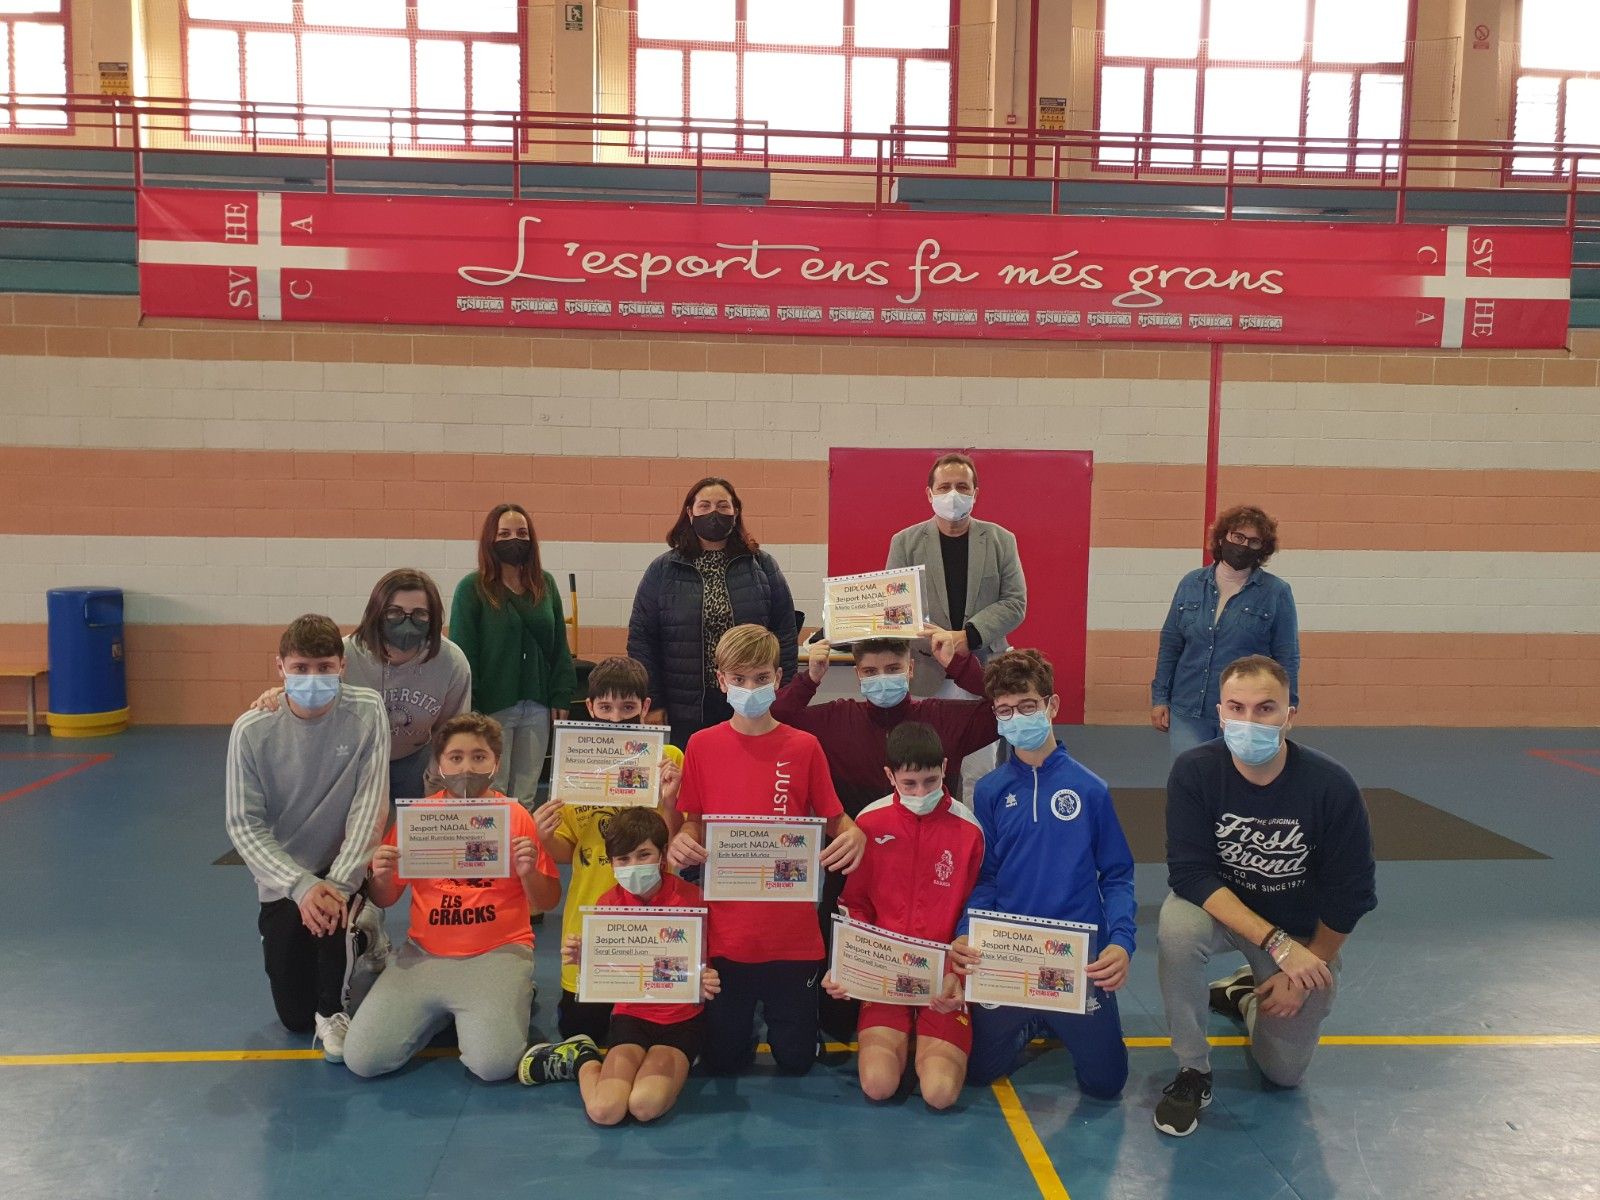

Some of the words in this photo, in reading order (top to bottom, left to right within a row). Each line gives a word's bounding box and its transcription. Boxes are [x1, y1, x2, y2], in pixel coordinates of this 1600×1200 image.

[289, 214, 313, 234] A
[457, 215, 819, 294] L'esport
[800, 257, 890, 286] ens
[896, 238, 979, 304] fa
[999, 250, 1104, 290] més
[1111, 264, 1285, 308] grans
[290, 279, 313, 300] C
[575, 302, 611, 312] SUECA
[736, 307, 770, 318] SUECA
[943, 312, 977, 322] SUECA
[995, 312, 1029, 323] SUECA
[1046, 313, 1080, 323] SUECA
[577, 736, 615, 744] DIPLOMA
[596, 747, 625, 756] NADAL
[774, 770, 790, 814] JUST
[420, 814, 460, 822] DIPLOMA
[1268, 818, 1300, 826] ORIGINAL
[730, 830, 769, 838] DIPLOMA
[1215, 813, 1307, 851] Fresh
[749, 841, 779, 849] NADAL
[1217, 841, 1309, 874] Brand
[1261, 883, 1287, 893] SINCE
[441, 894, 463, 909] ELS
[429, 904, 497, 926] CRACKS
[607, 924, 648, 932] DIPLOMA
[992, 929, 1033, 942] DIPLOMA
[627, 936, 659, 944] NADAL
[855, 935, 893, 952] DIPLOMA
[981, 939, 1010, 951] 3esport
[1012, 944, 1045, 955] NADAL
[872, 950, 902, 965] NADAL
